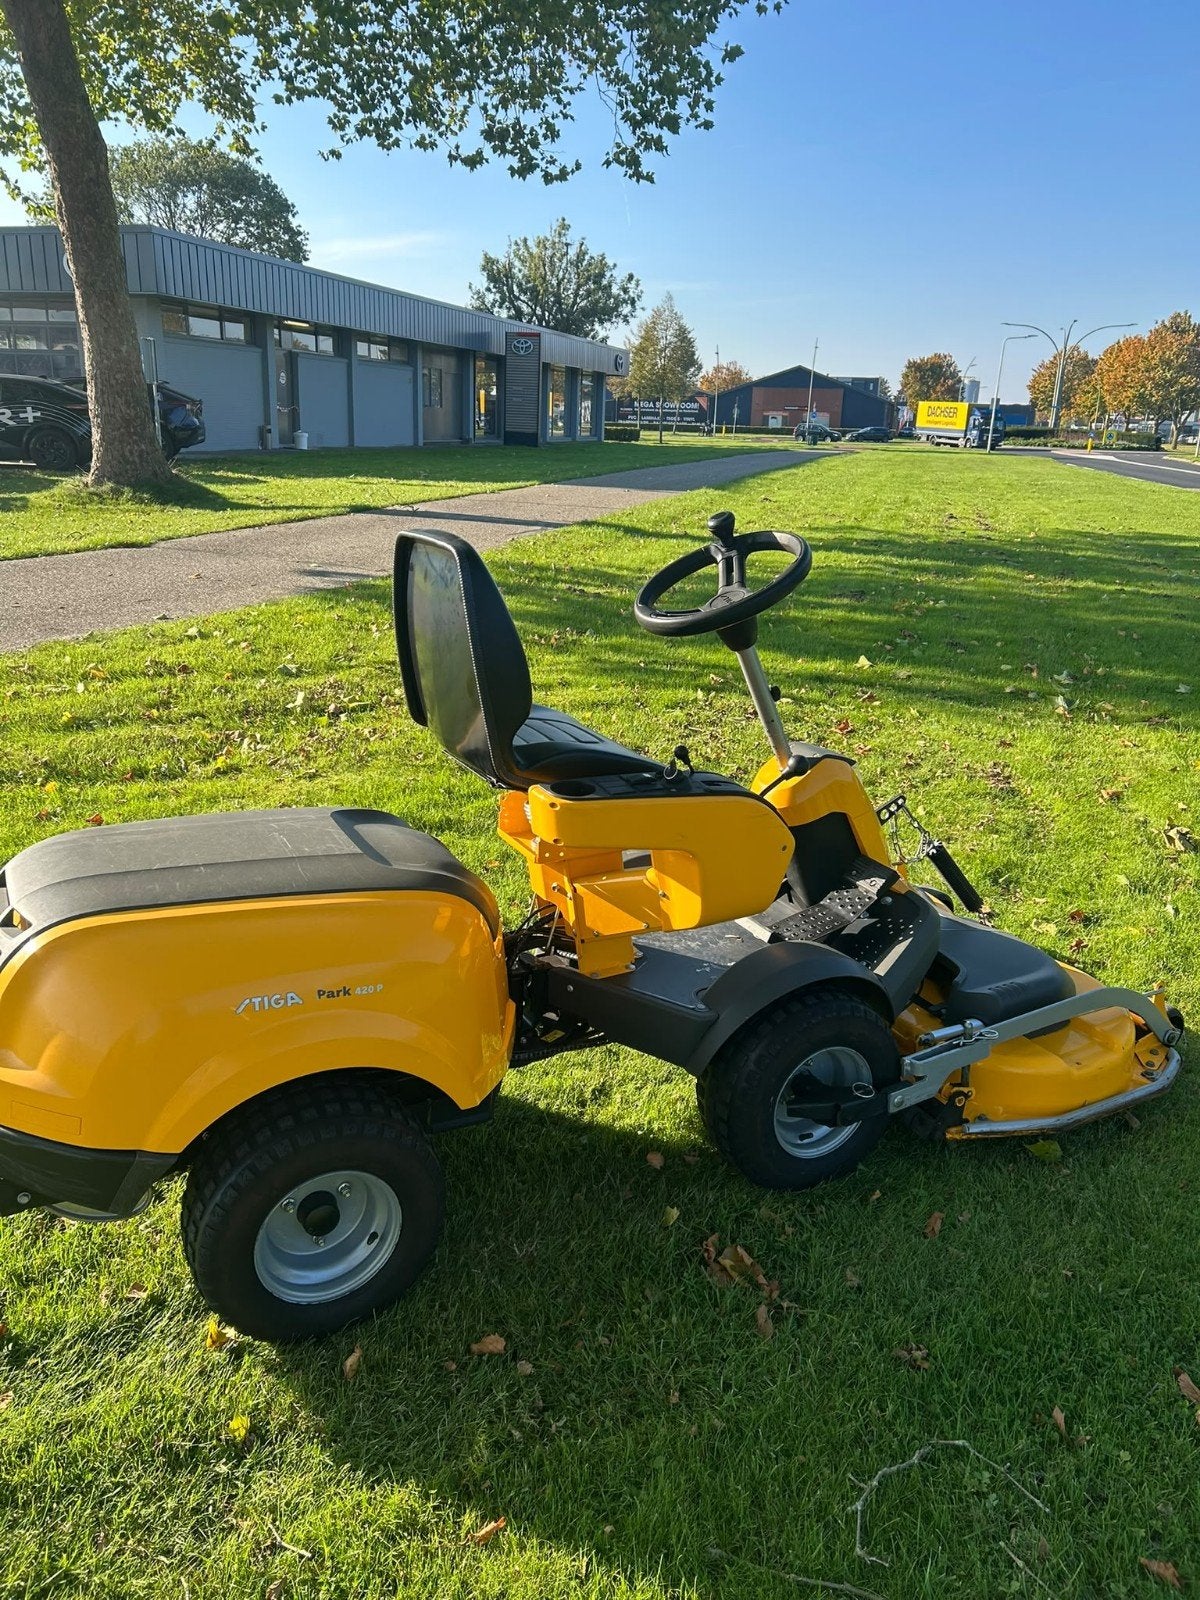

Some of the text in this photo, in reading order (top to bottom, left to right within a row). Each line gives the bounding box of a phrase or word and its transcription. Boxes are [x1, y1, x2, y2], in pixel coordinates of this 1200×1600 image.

[927, 406, 958, 419] DACHSER
[235, 983, 384, 1015] STIGA Park 420 P
